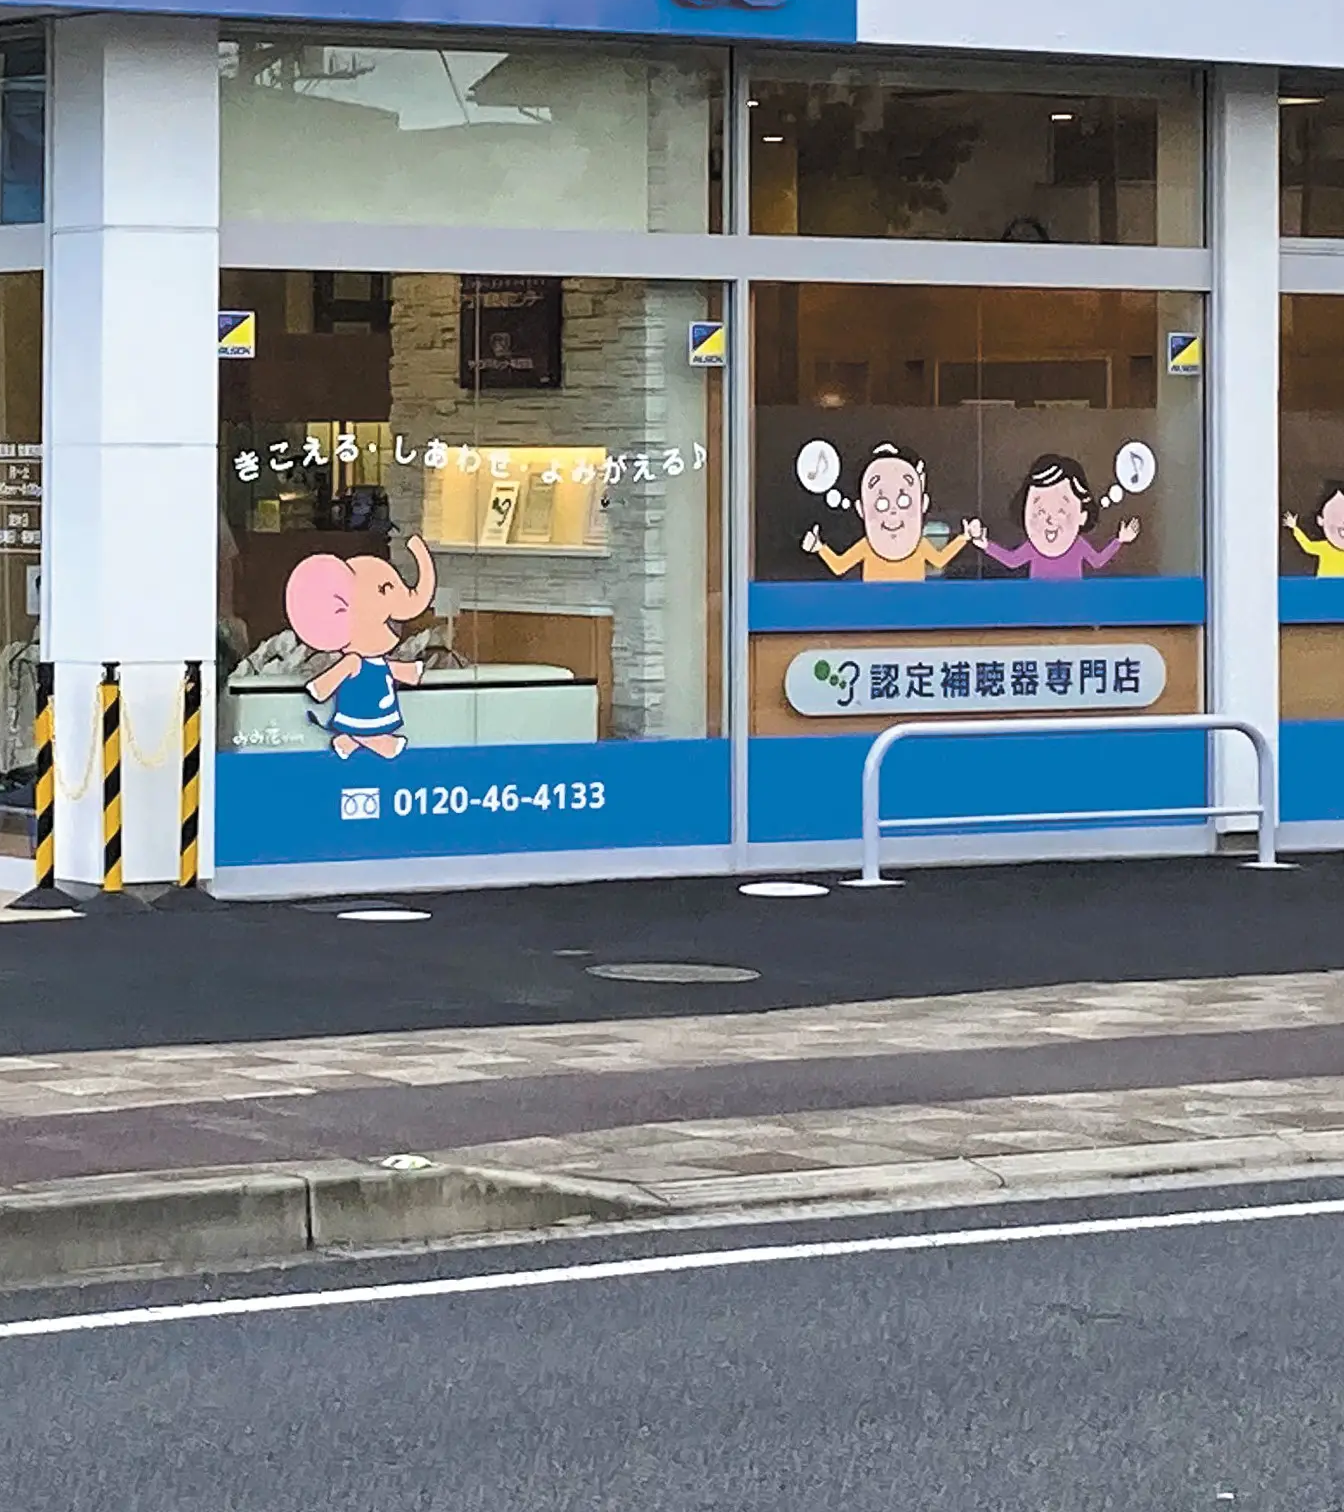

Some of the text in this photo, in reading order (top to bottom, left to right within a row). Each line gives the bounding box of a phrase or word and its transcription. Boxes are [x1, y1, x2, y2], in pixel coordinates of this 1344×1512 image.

[869, 656, 1142, 700] 認定補聴器専門店
[393, 781, 606, 817] 0120-46-4133
